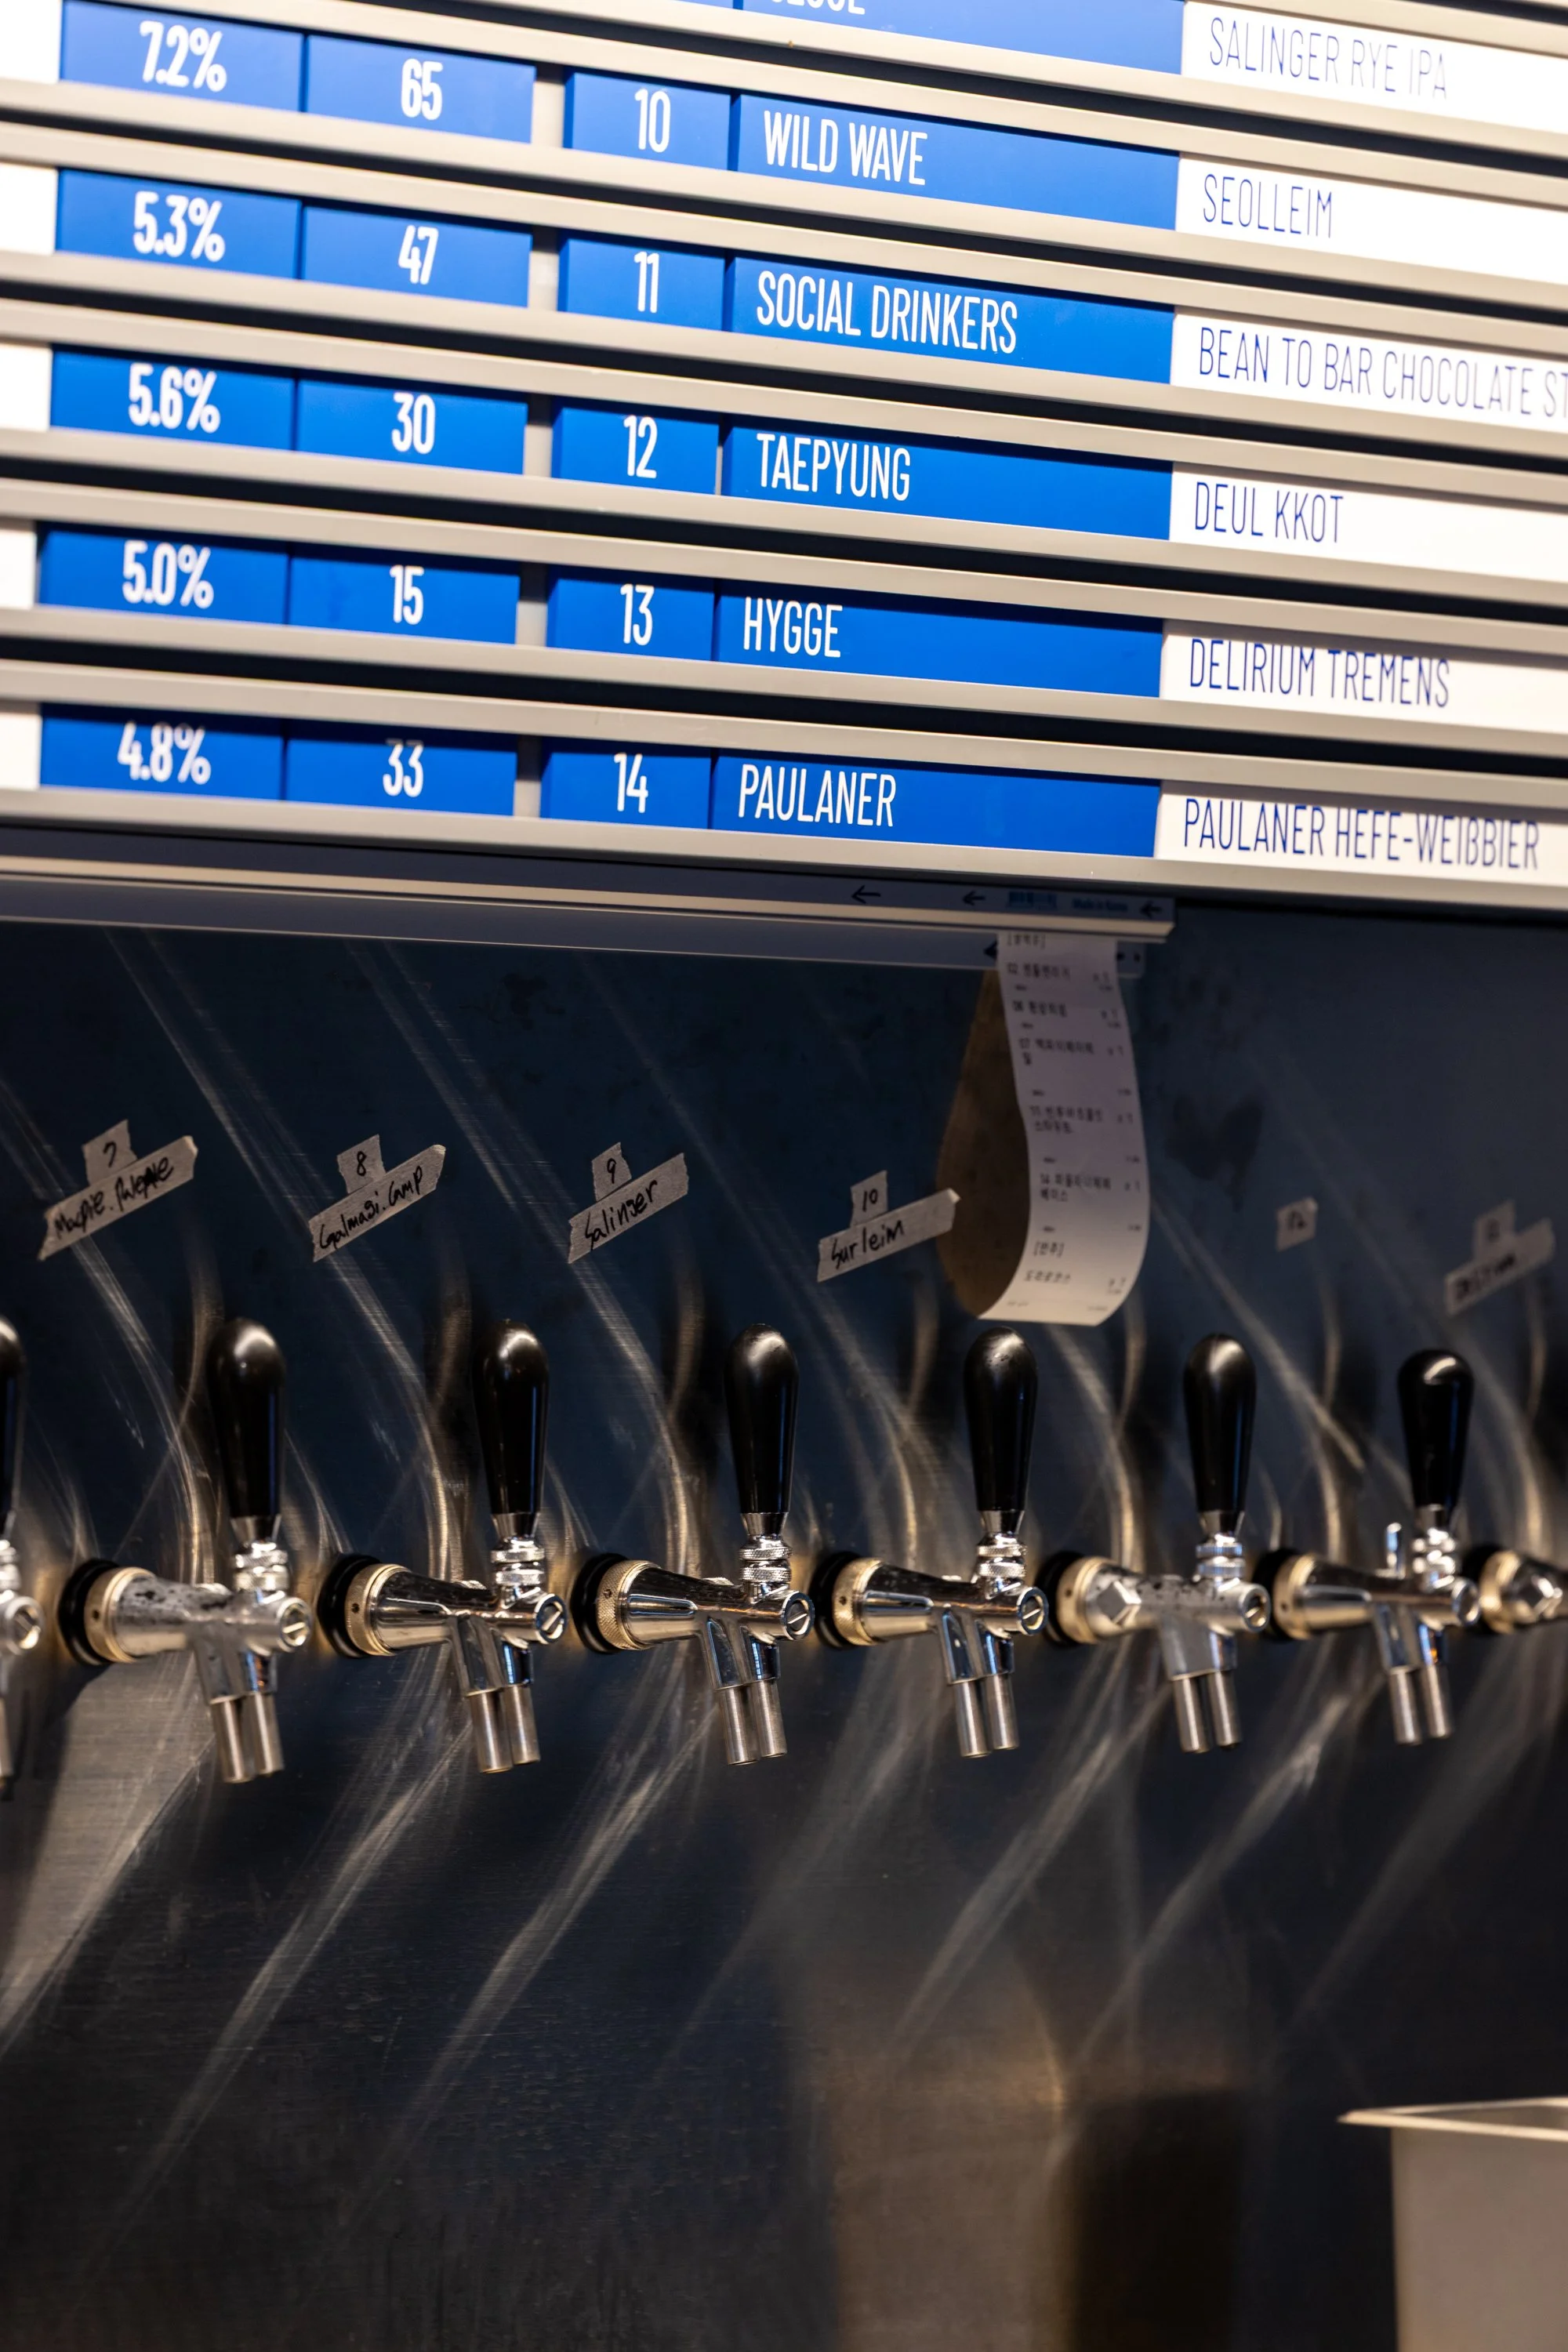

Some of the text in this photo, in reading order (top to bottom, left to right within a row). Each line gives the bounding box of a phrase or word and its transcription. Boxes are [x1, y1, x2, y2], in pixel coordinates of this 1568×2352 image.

[140, 20, 227, 93] 7.2%
[1209, 16, 1448, 100] SALINGER RYE IPA
[401, 58, 443, 120] 65
[634, 88, 670, 153] 10
[764, 111, 928, 185] WILD WAVE
[133, 191, 226, 262] 5.3%
[1203, 173, 1333, 239] SEOLLEIM
[398, 225, 439, 285] 47
[634, 252, 660, 314] 11
[757, 270, 1018, 354] SOCIAL DRINKERS
[129, 363, 220, 434] 5.6%
[1200, 327, 1269, 383] BEAN
[1283, 338, 1312, 388] TO
[1324, 343, 1372, 395] BAR
[1383, 350, 1534, 415] CHOCOLATE
[392, 392, 435, 454] 30
[624, 416, 658, 479] 12
[757, 433, 910, 501] TAEPYUNG
[1195, 481, 1344, 543] DEUL KKOT
[122, 540, 214, 609] 5.0%
[390, 565, 424, 625] 15
[621, 584, 654, 646] 13
[744, 597, 843, 657] HYGGE
[1190, 638, 1450, 708] DELIRIUM TREMENS
[118, 720, 212, 785] 4.8%
[383, 740, 424, 798] 33
[615, 753, 648, 813] 14
[739, 764, 896, 826] PAULANER
[1184, 798, 1325, 856] PAULANER
[103, 1142, 117, 1168] 7
[357, 1151, 367, 1176] 8
[607, 1158, 617, 1184] 9
[862, 1189, 878, 1212] 10
